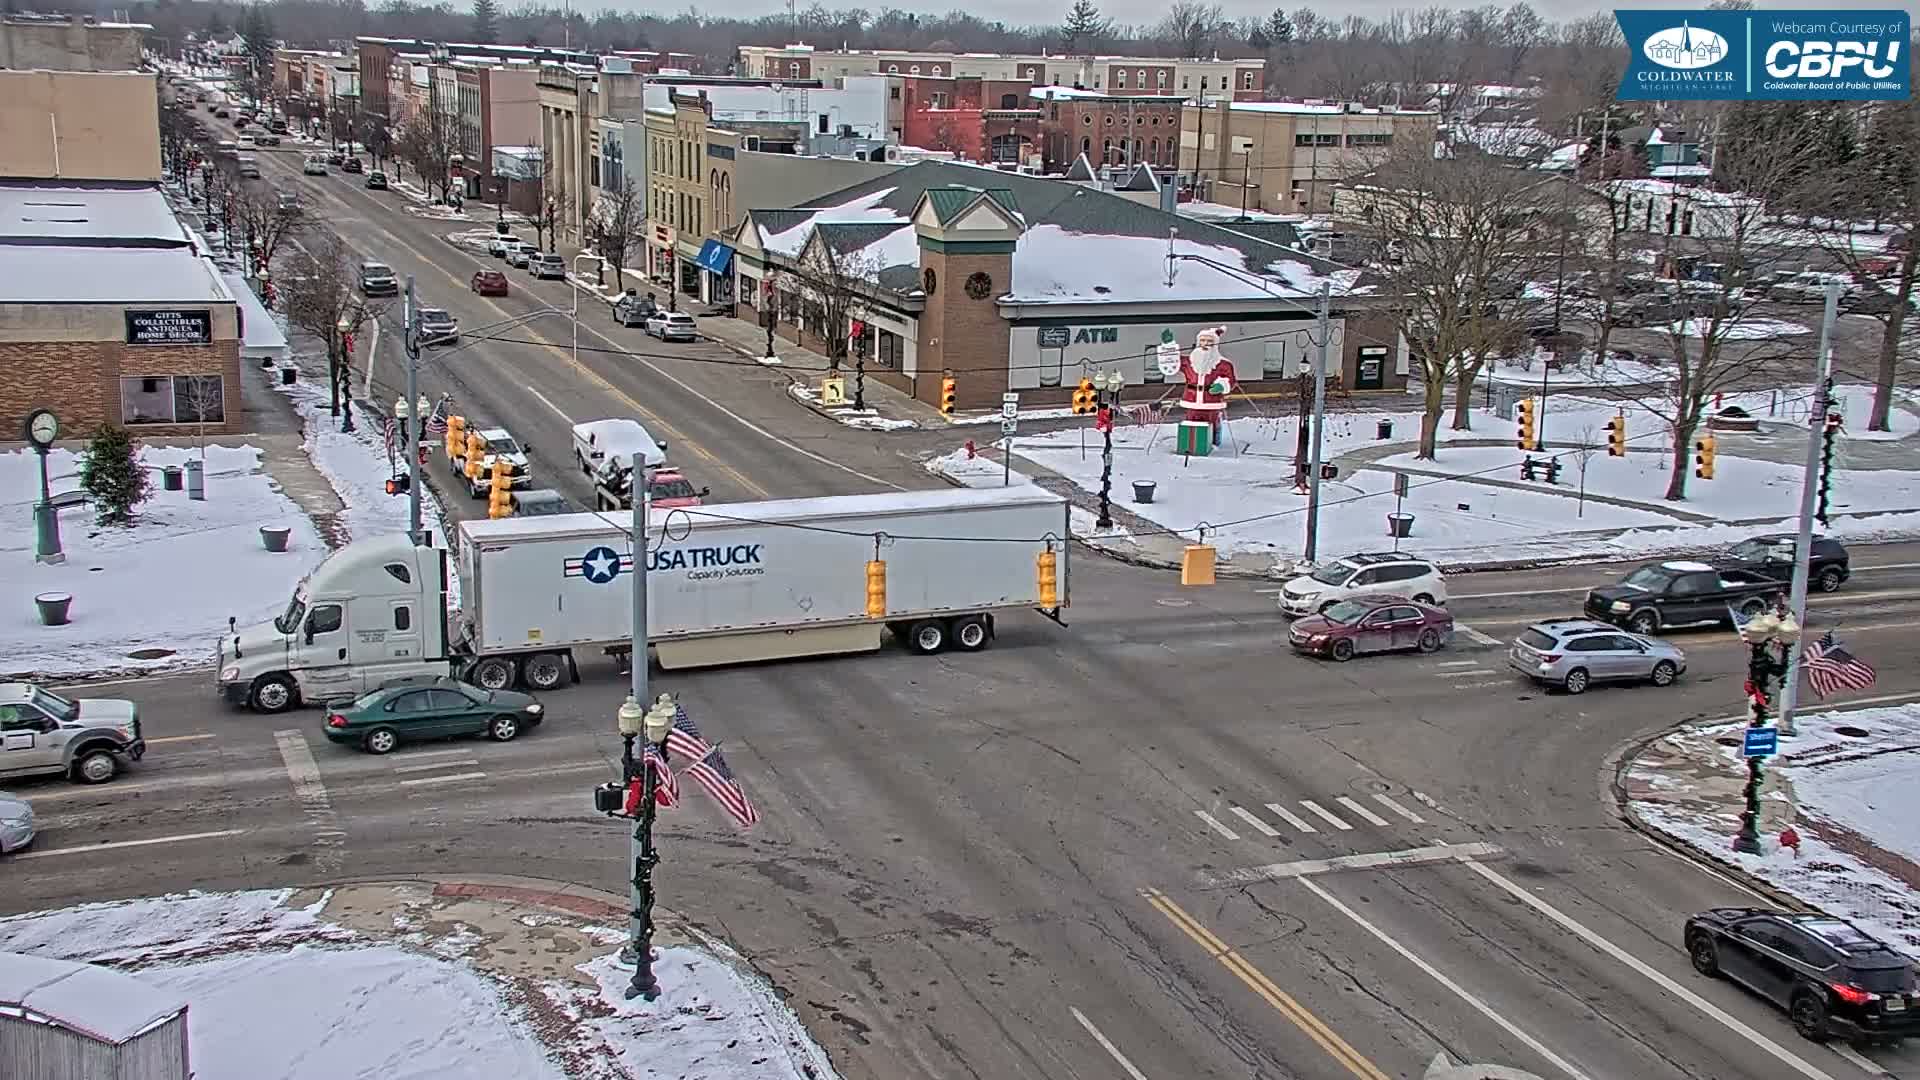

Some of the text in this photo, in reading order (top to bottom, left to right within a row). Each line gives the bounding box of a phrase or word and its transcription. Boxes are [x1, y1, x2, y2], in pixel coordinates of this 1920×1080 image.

[137, 331, 165, 339] HOME
[1074, 328, 1118, 344] ATM
[646, 544, 760, 571] USA TRUCK
[688, 567, 765, 581] Capacity Solutions
